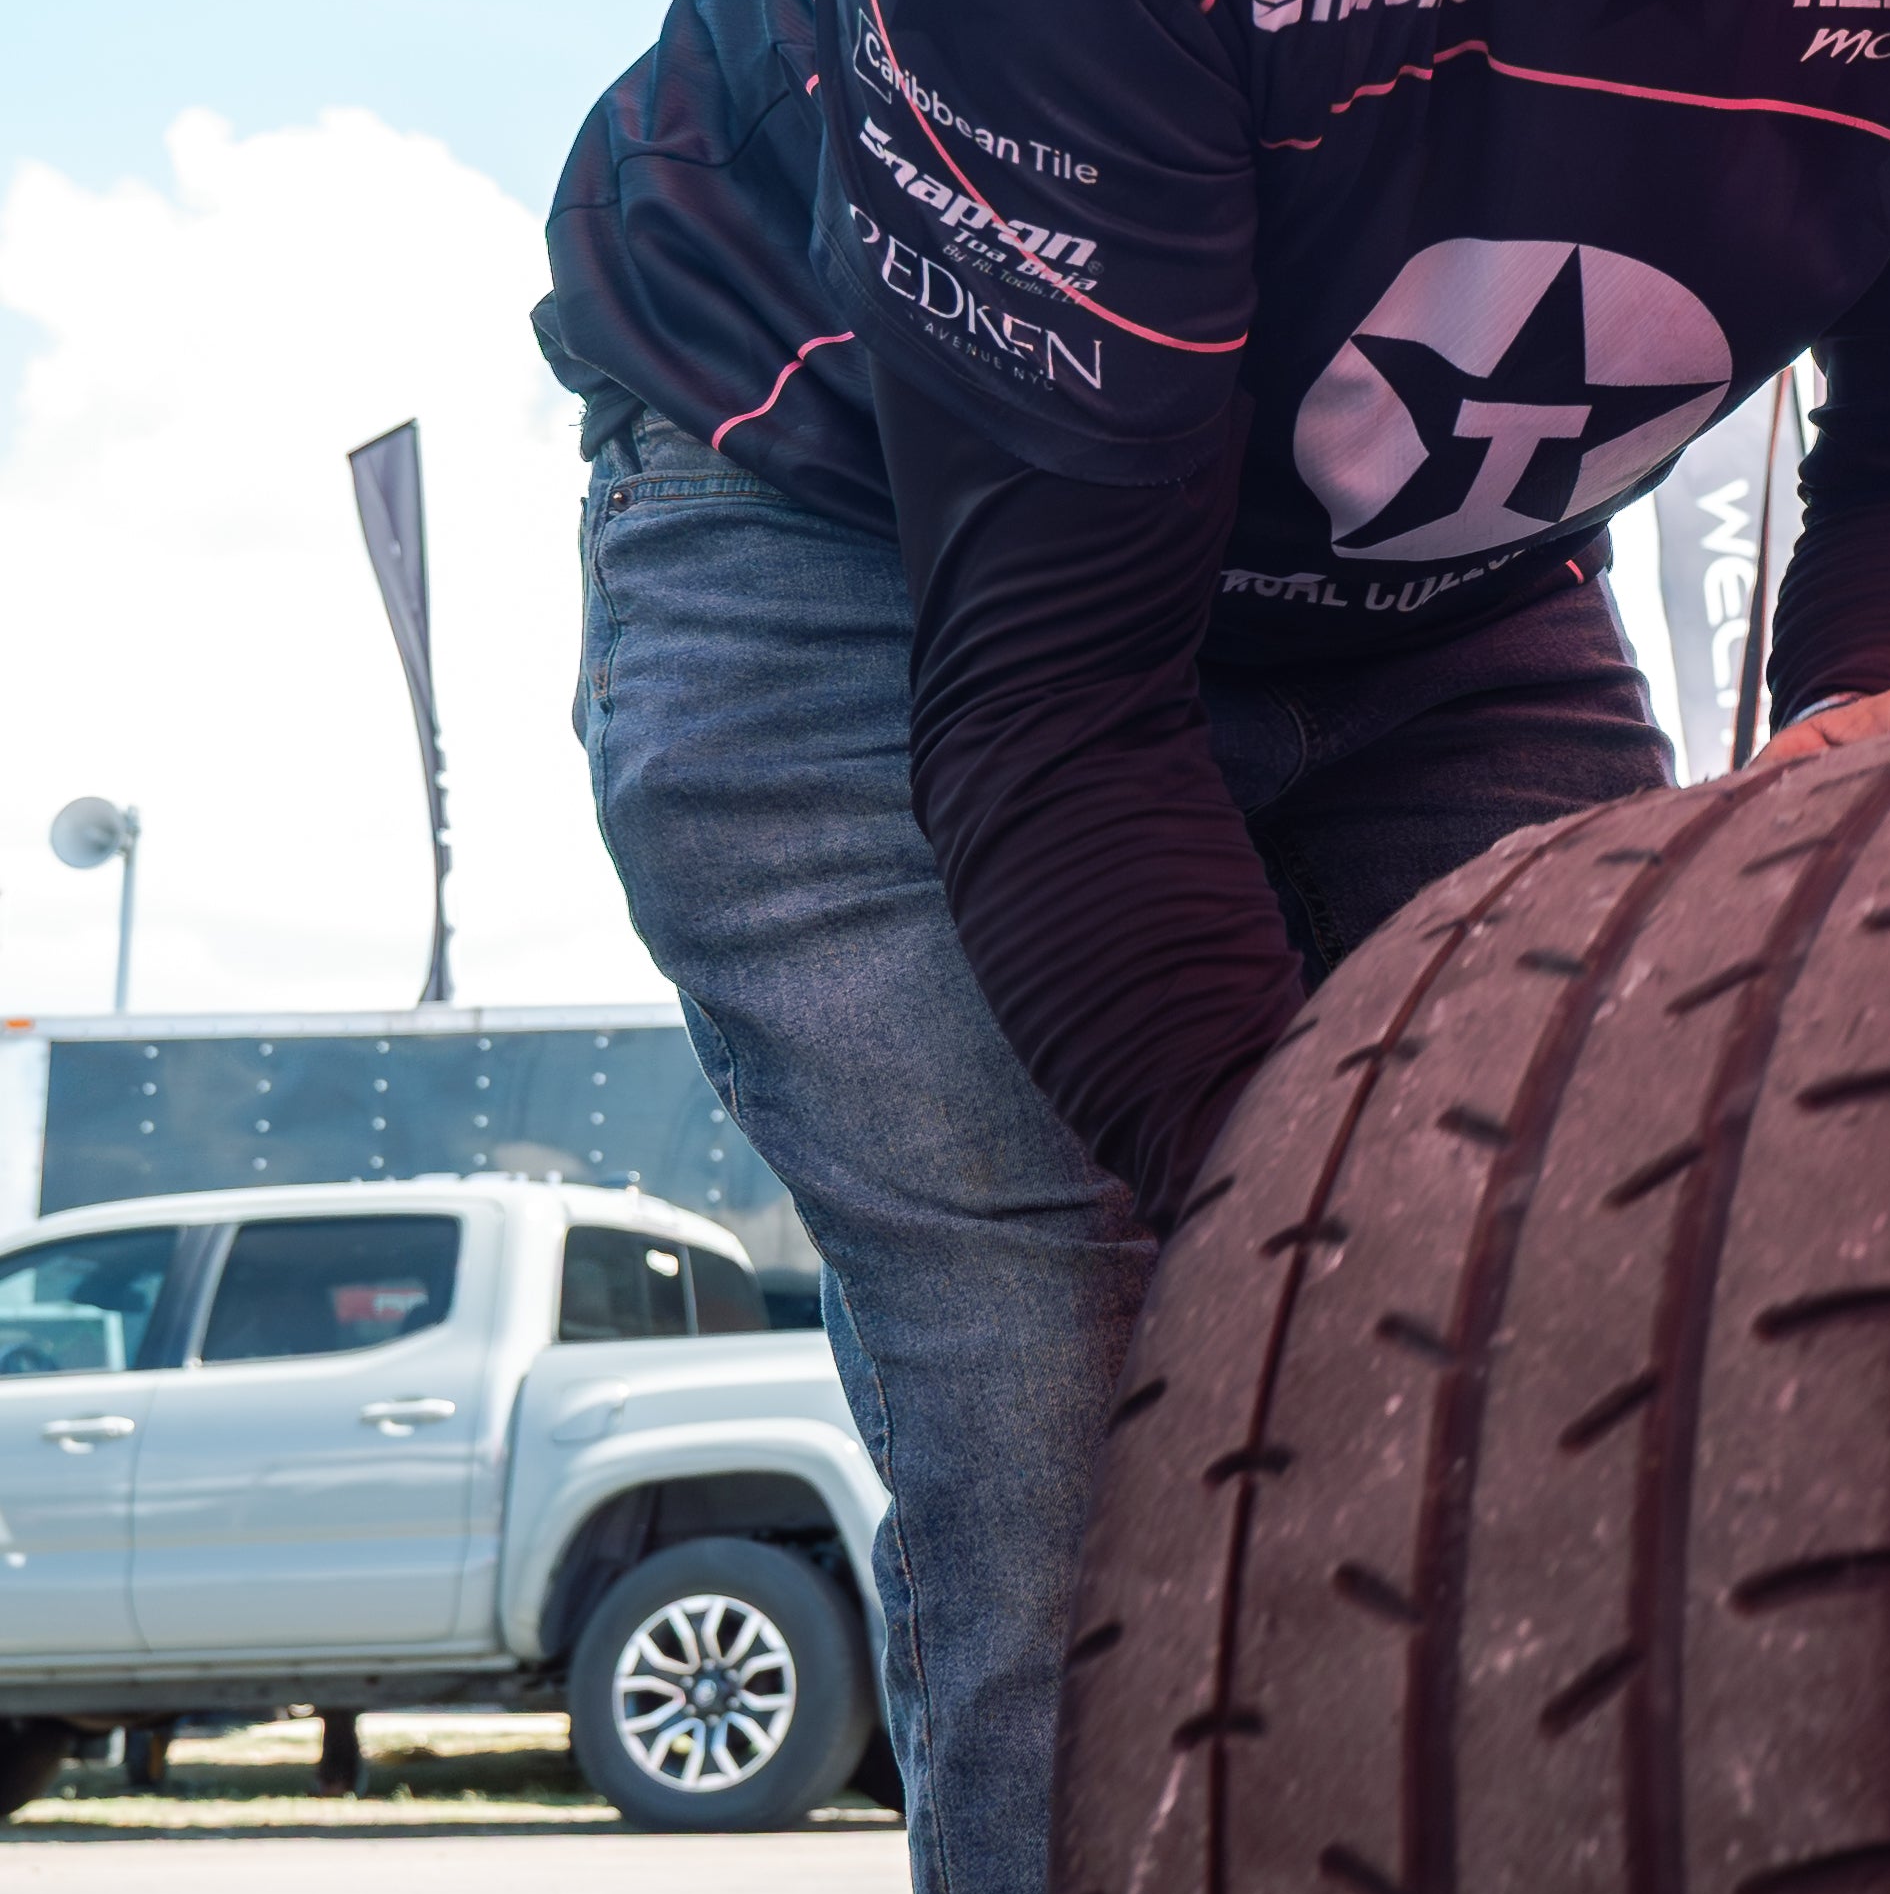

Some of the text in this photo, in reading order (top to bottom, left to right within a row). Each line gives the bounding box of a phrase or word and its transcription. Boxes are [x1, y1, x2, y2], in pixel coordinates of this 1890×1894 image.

[864, 31, 1099, 185] Caribbean Tile
[953, 228, 1007, 264] Toa
